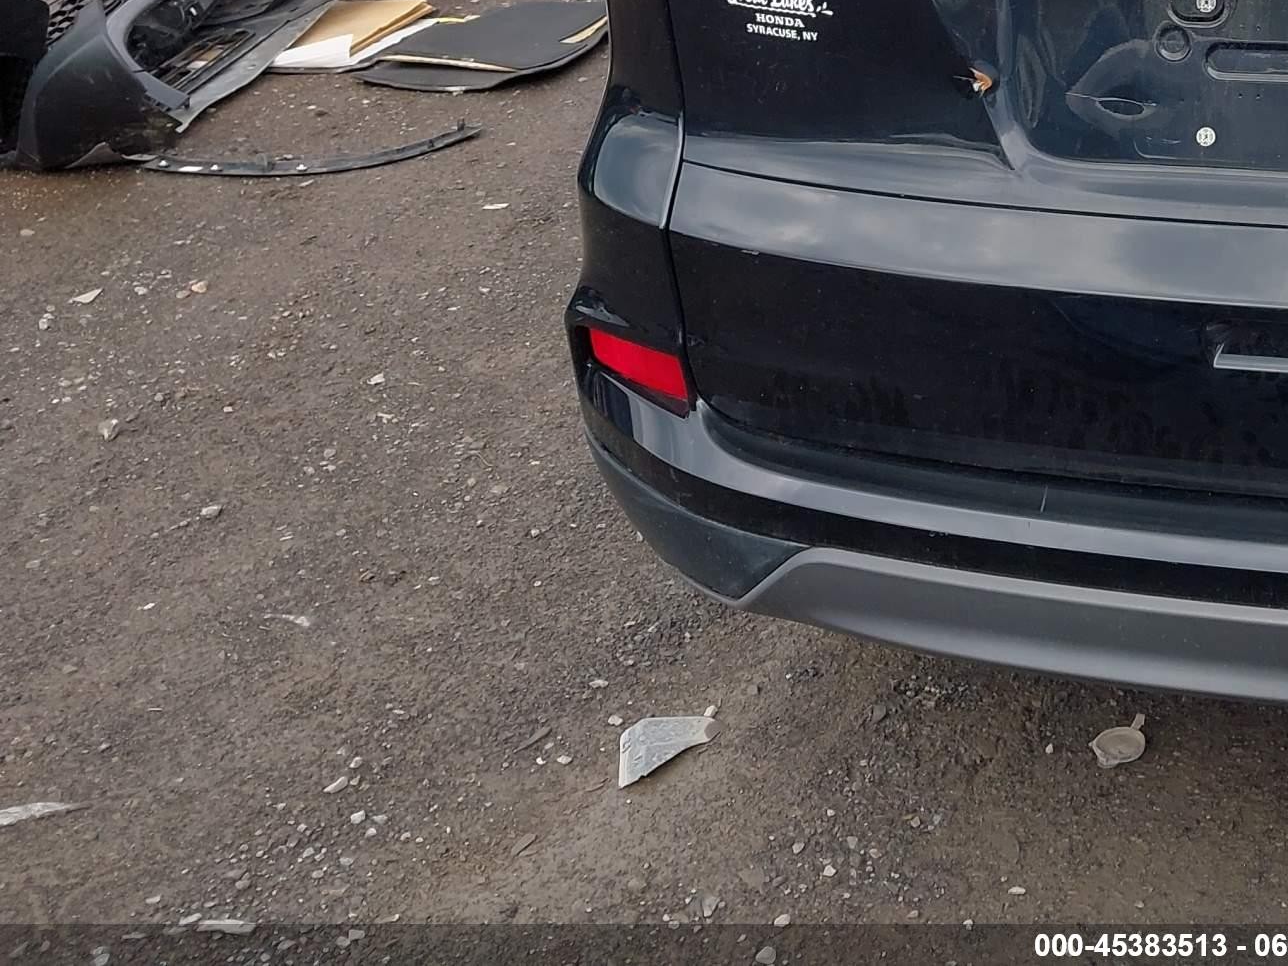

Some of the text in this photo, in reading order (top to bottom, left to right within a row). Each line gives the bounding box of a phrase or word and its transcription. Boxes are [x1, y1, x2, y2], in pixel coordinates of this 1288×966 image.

[755, 13, 805, 28] HONDA
[746, 23, 818, 41] SYRACUSE, NY
